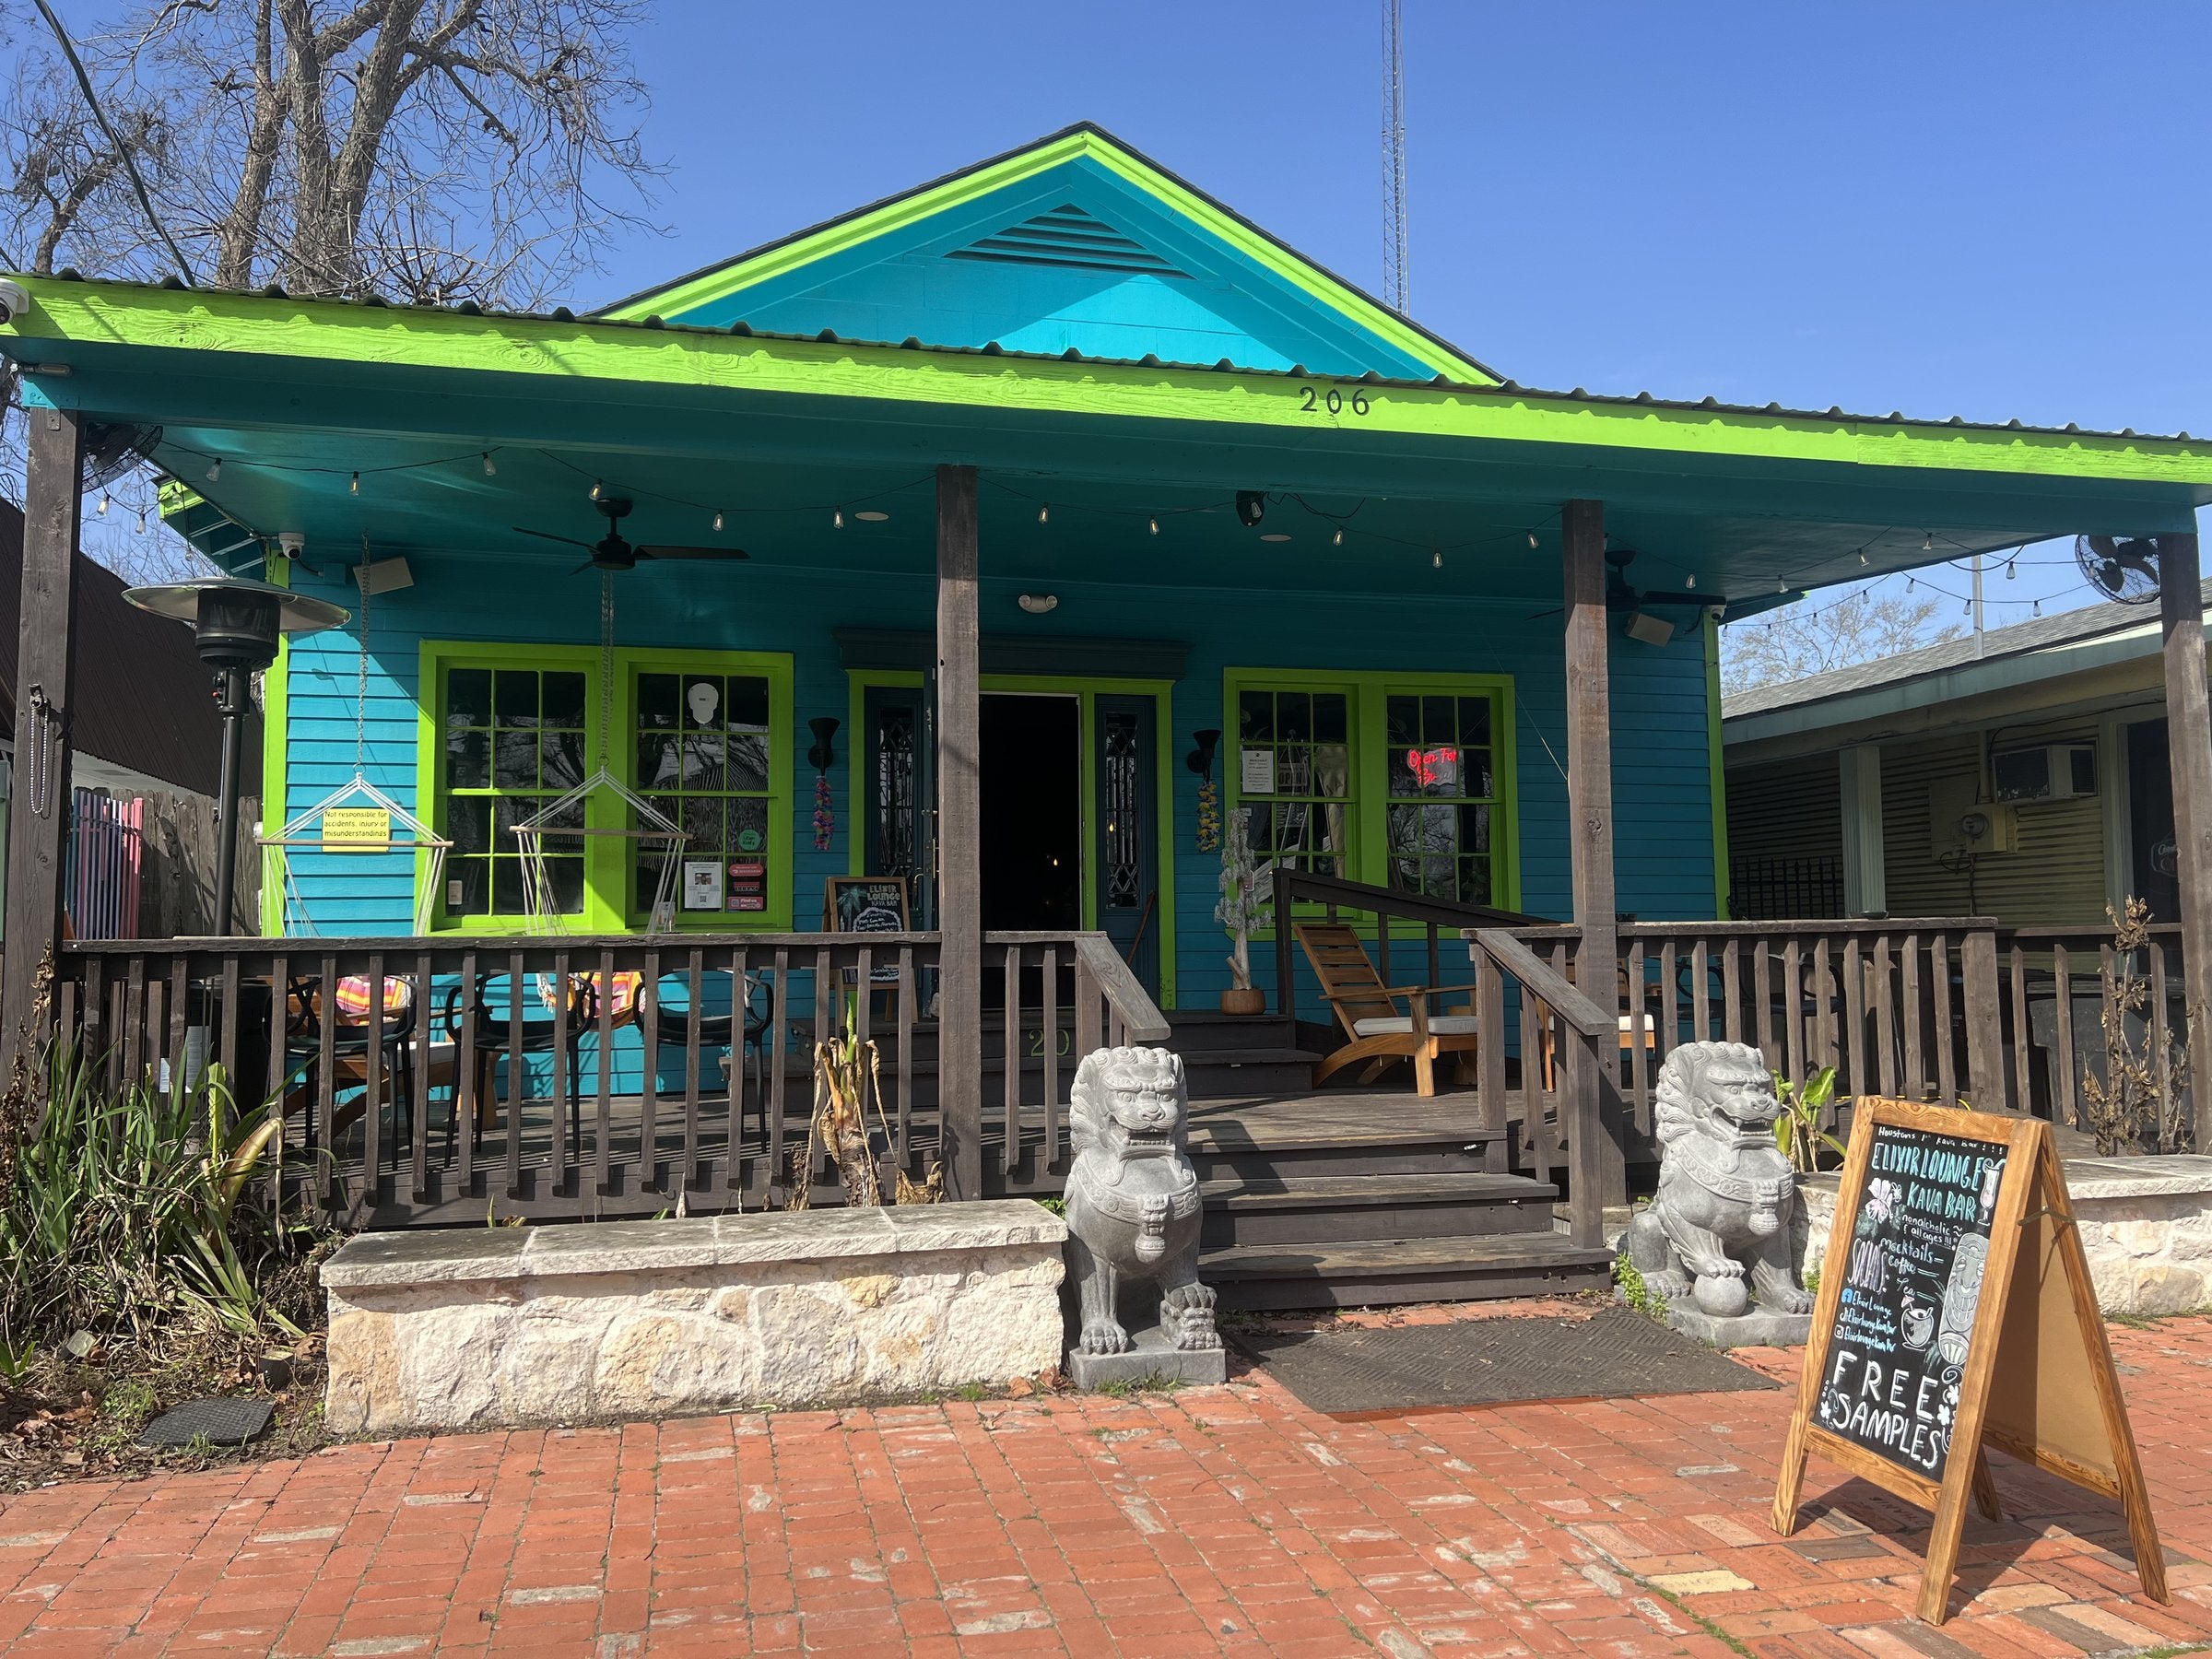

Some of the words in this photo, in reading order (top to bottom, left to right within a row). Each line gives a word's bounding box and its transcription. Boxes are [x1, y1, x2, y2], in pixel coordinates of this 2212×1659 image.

[1300, 386, 1370, 416] 206
[338, 811, 376, 819] responsible
[359, 820, 378, 829] injury
[324, 830, 387, 838] misunderstandings
[1871, 1142, 1920, 1176] ELIXIR
[1919, 1147, 1985, 1192] LOUNGE
[1906, 1181, 1944, 1216] KAVA
[1944, 1190, 1978, 1223] BAR
[1832, 1349, 1939, 1423] FREE
[1832, 1393, 1942, 1469] SAMPLES
